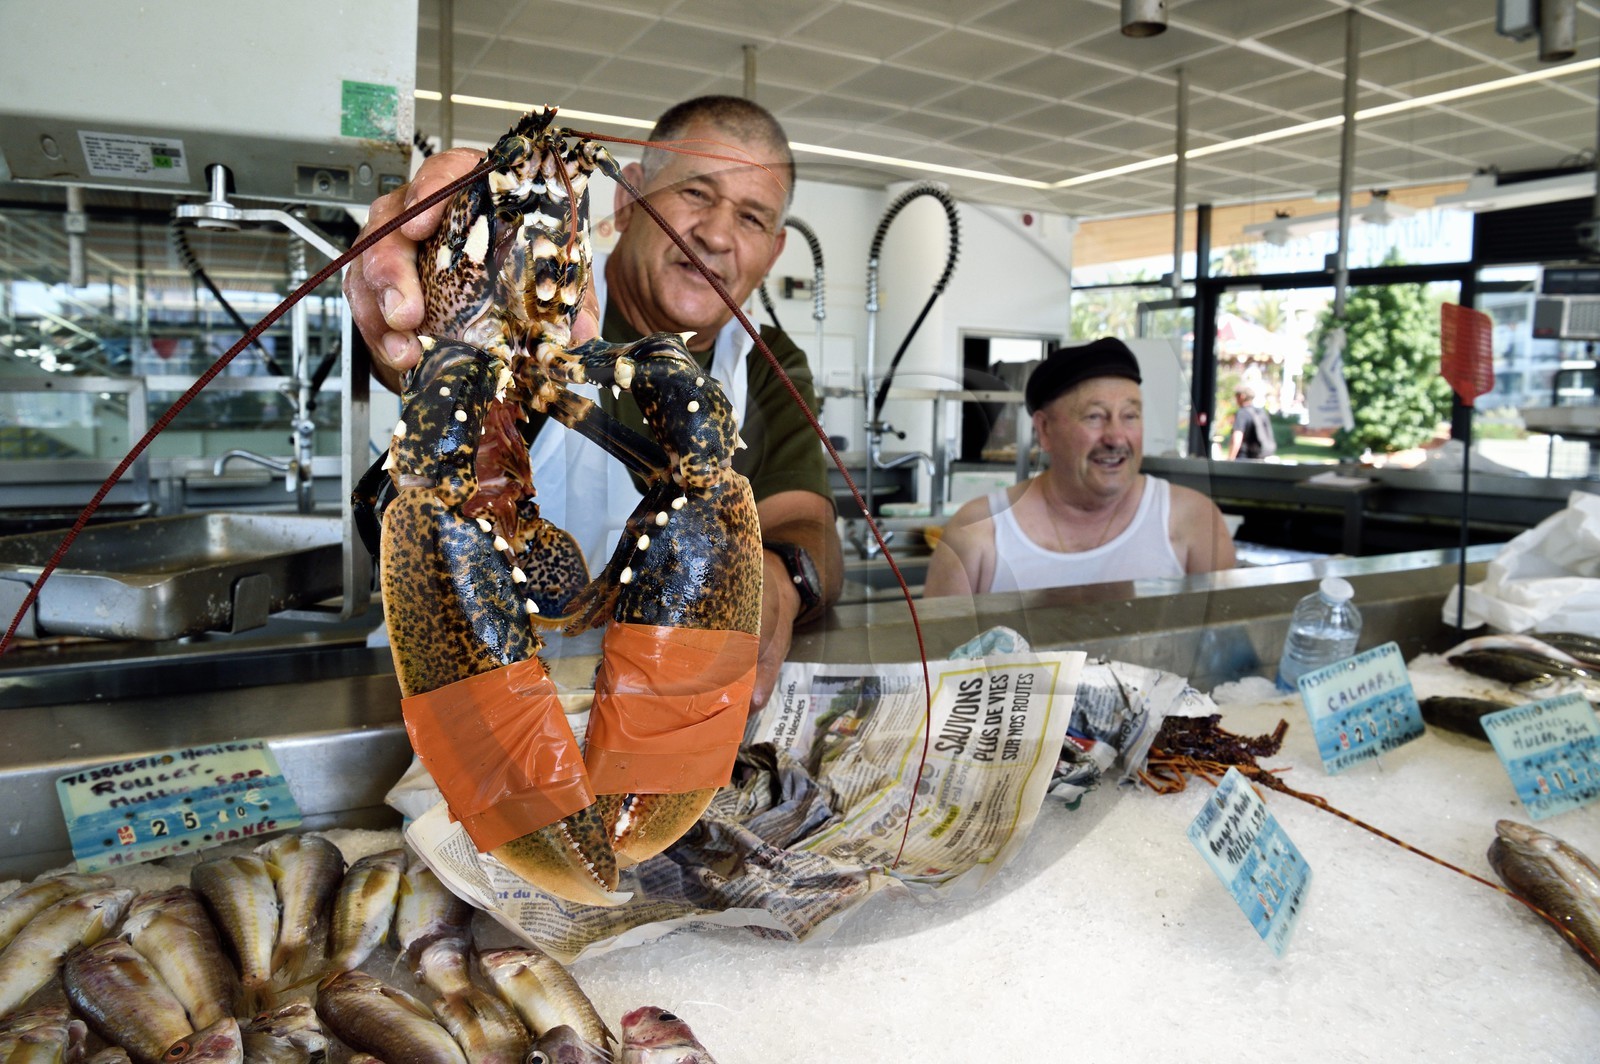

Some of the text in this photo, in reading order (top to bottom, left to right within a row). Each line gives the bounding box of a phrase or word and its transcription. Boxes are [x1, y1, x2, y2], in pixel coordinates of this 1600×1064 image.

[987, 673, 1010, 706] VIES
[774, 721, 787, 738] silo
[783, 680, 798, 715] grains,
[788, 698, 806, 736] blessées
[934, 677, 984, 756] SAUVONS
[983, 706, 1004, 726] DE
[1001, 673, 1035, 761] SUR NOS ROUTES
[972, 727, 1001, 762] PLUS
[513, 889, 531, 899] du
